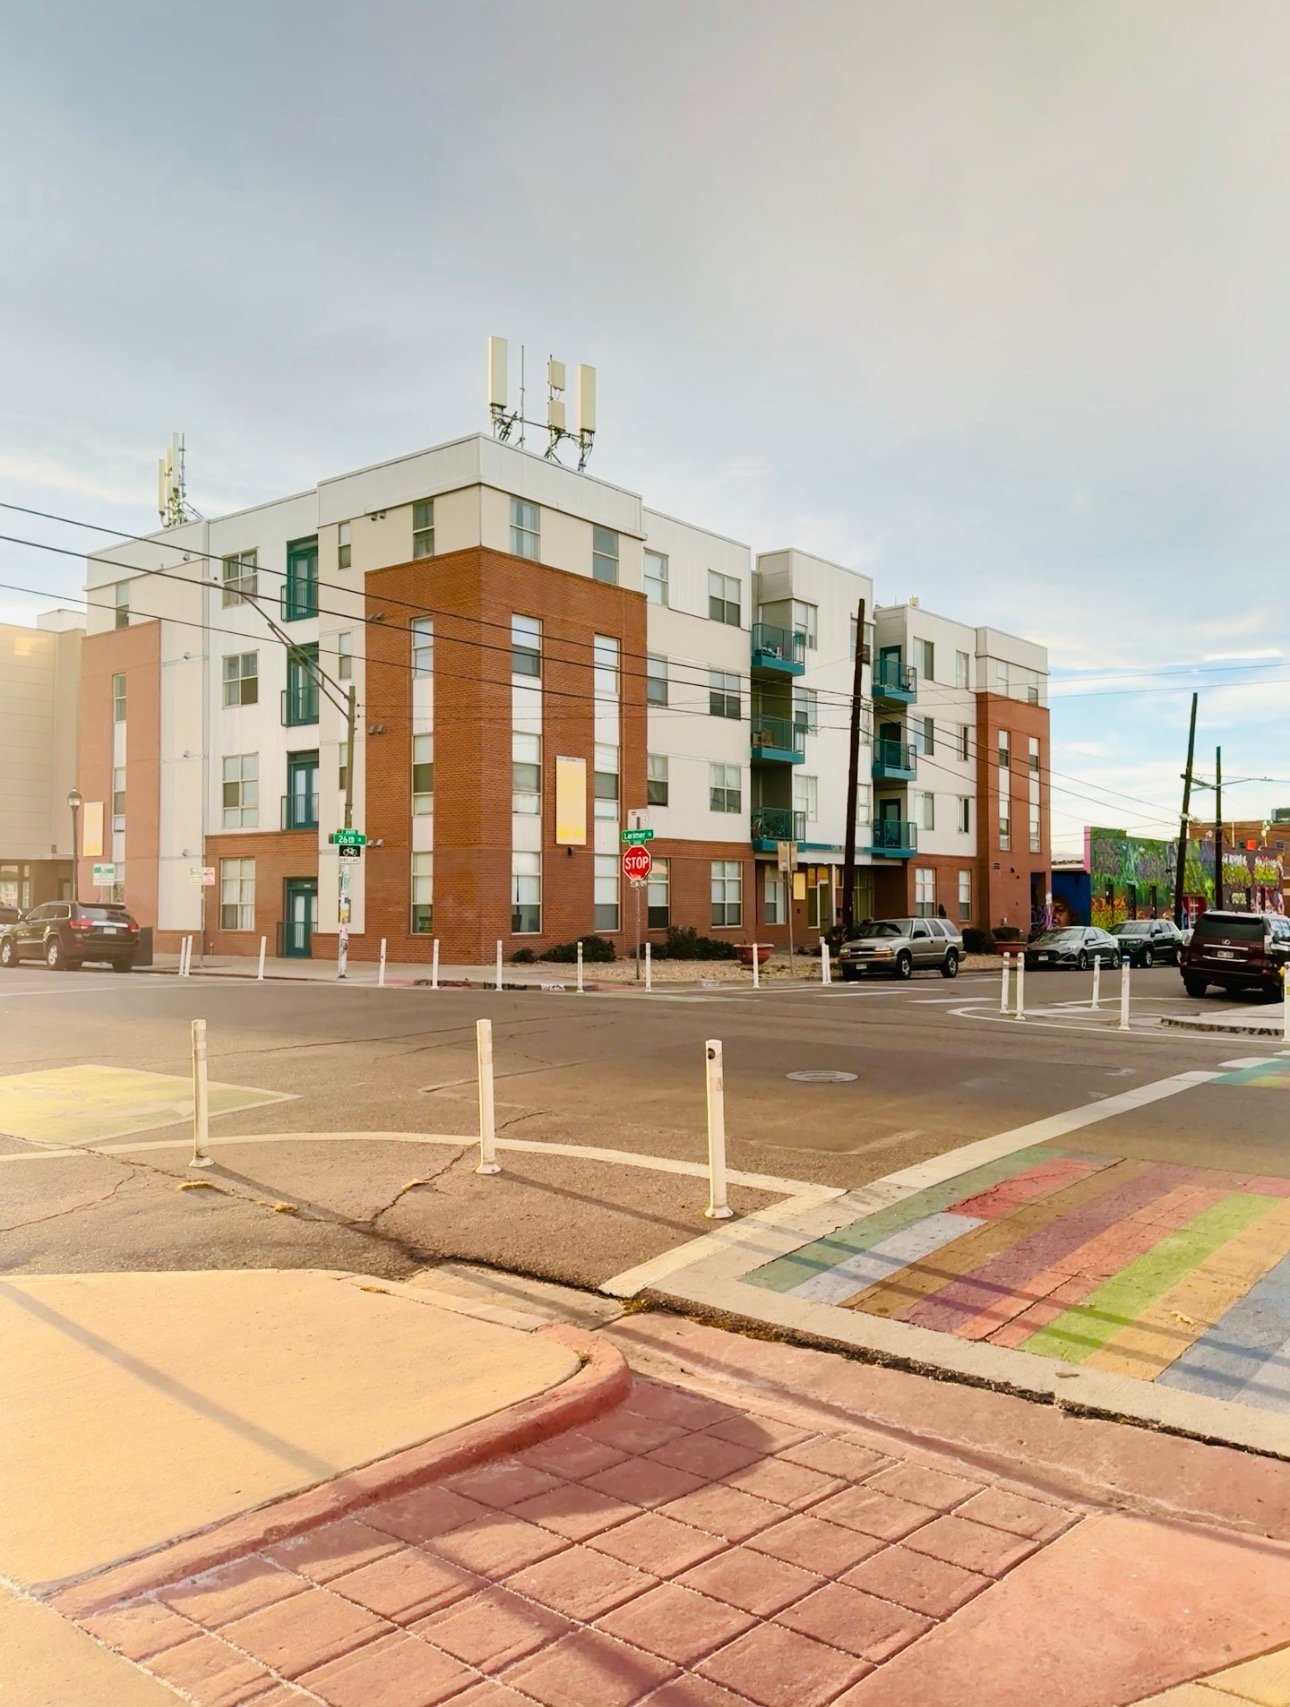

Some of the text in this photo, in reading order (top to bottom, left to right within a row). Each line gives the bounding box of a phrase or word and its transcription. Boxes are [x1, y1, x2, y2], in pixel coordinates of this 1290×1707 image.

[338, 835, 355, 844] 26th
[624, 832, 646, 840] Larimer
[625, 856, 649, 870] STOP
